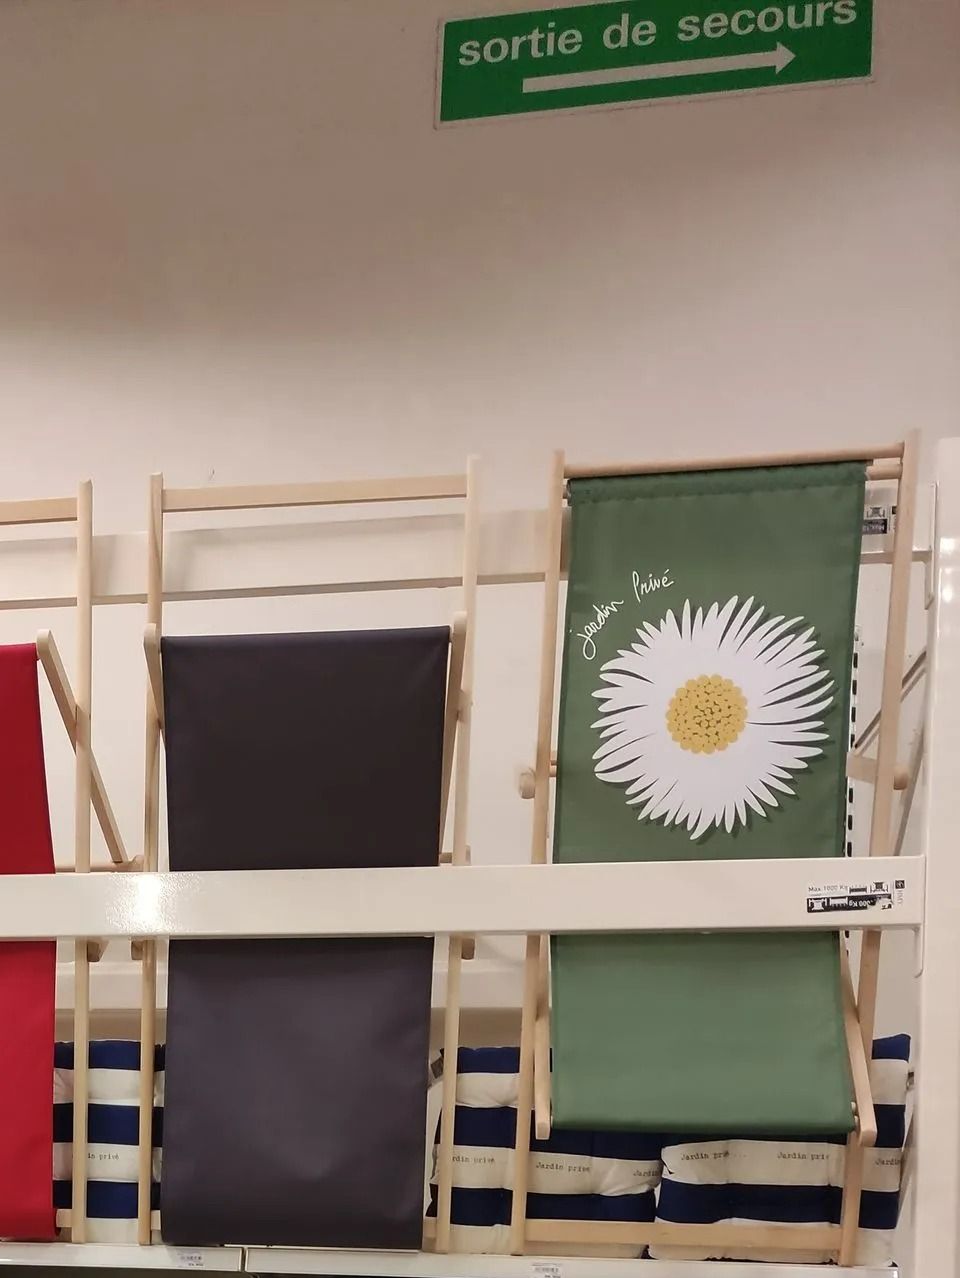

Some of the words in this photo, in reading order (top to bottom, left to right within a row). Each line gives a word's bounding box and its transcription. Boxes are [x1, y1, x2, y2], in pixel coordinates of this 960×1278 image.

[458, 22, 583, 66] sortie
[602, 13, 657, 50] de
[676, 0, 858, 42] secours
